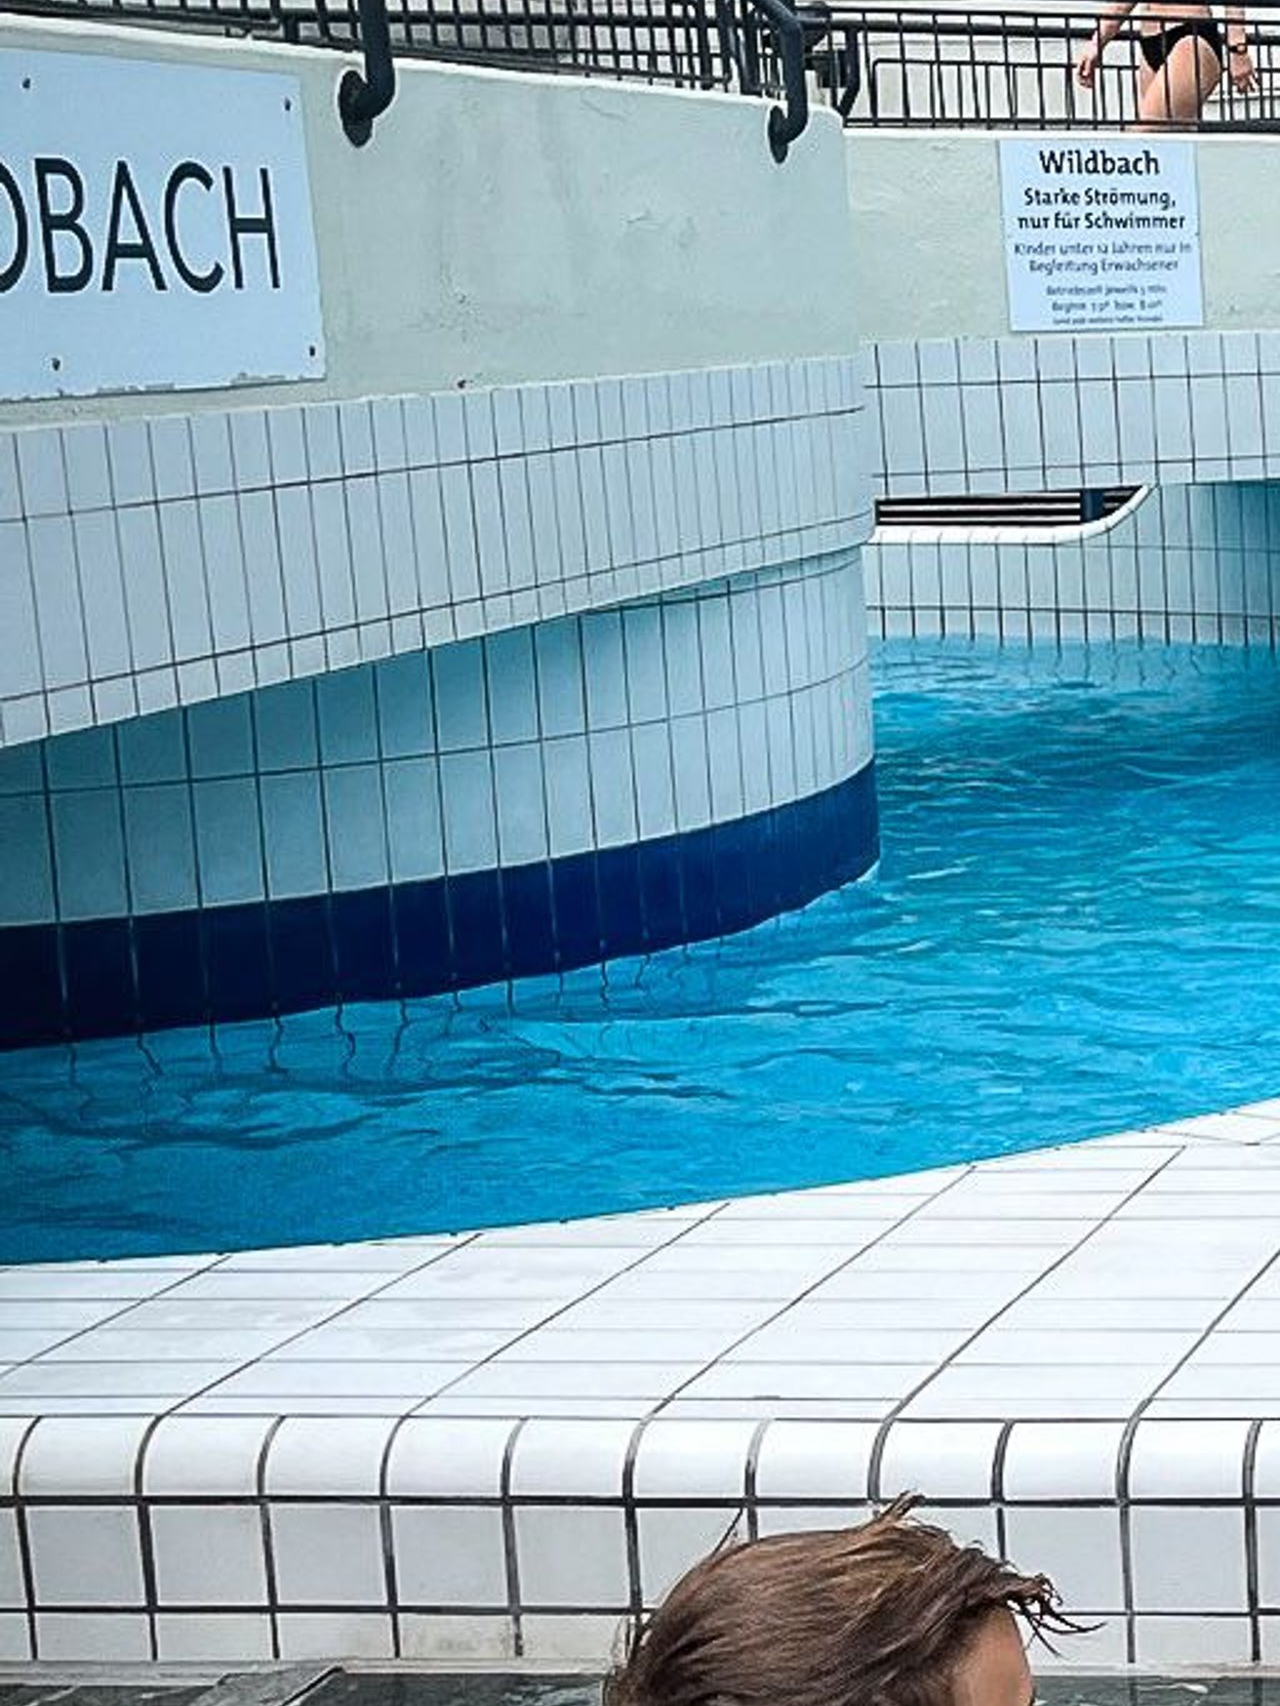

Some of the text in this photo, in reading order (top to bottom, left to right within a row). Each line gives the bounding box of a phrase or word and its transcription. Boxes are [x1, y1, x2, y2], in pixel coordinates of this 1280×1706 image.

[1039, 150, 1160, 175] Wildbach
[1024, 187, 1176, 210] Starke Strömung,
[1018, 212, 1185, 229] nur für Schwimmer
[1029, 259, 1098, 275] Begleitung
